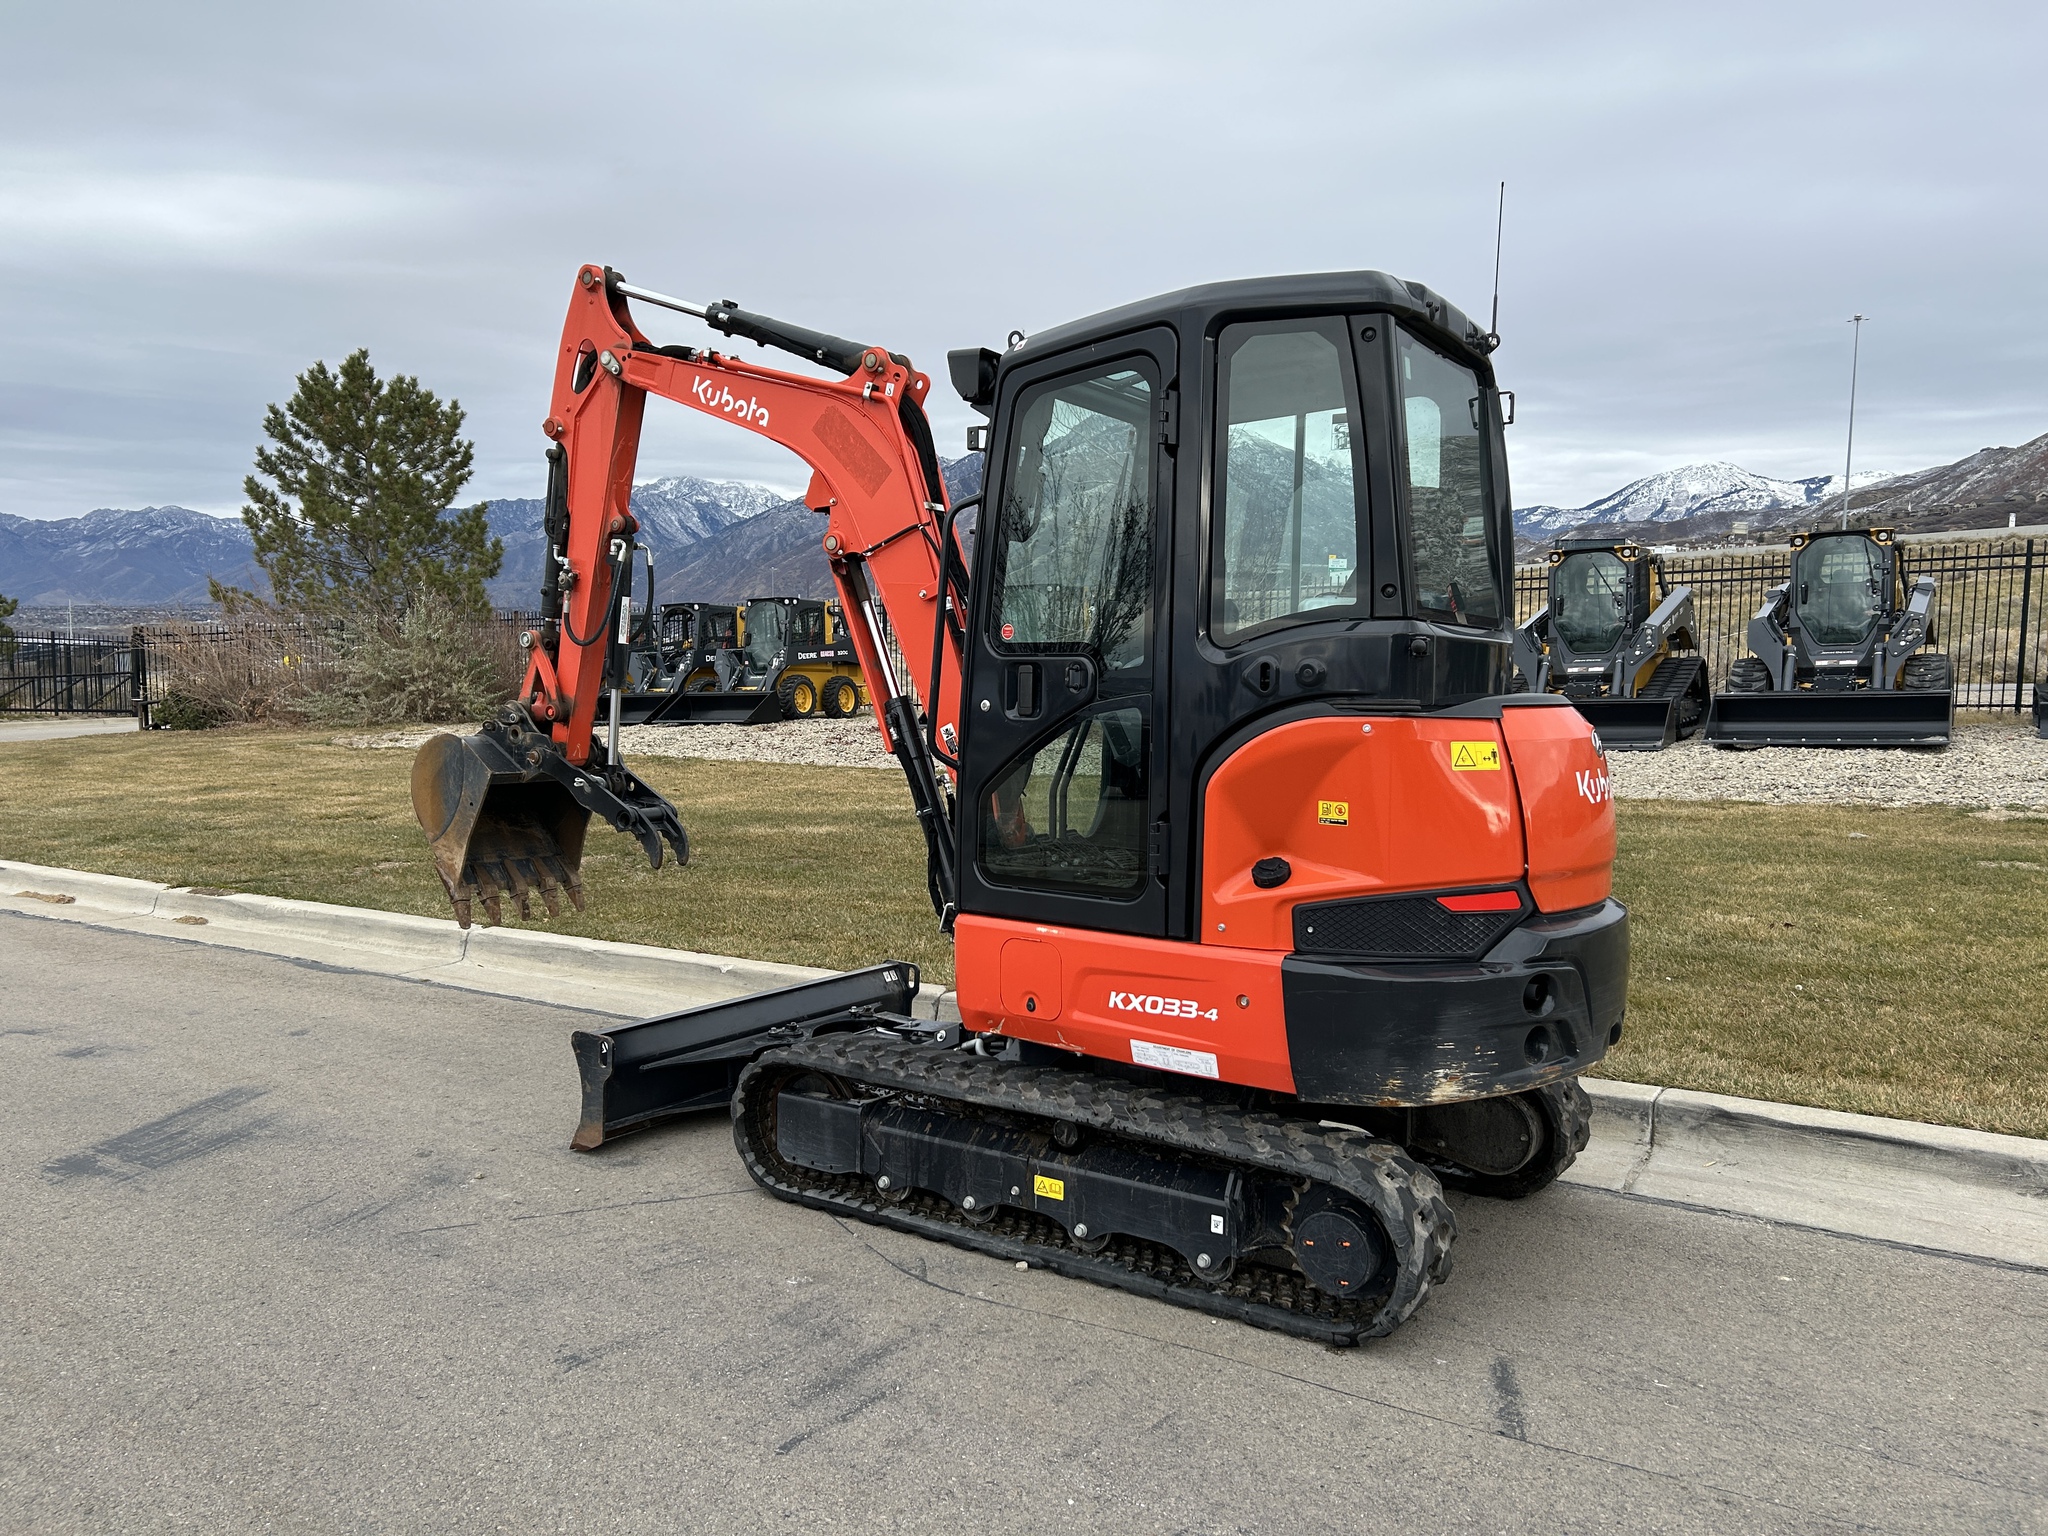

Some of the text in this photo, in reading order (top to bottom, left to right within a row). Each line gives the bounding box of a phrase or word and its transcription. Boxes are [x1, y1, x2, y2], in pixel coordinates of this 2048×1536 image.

[692, 375, 769, 427] Kubota
[797, 652, 818, 660] DEERE
[1108, 991, 1218, 1021] KX033-4
